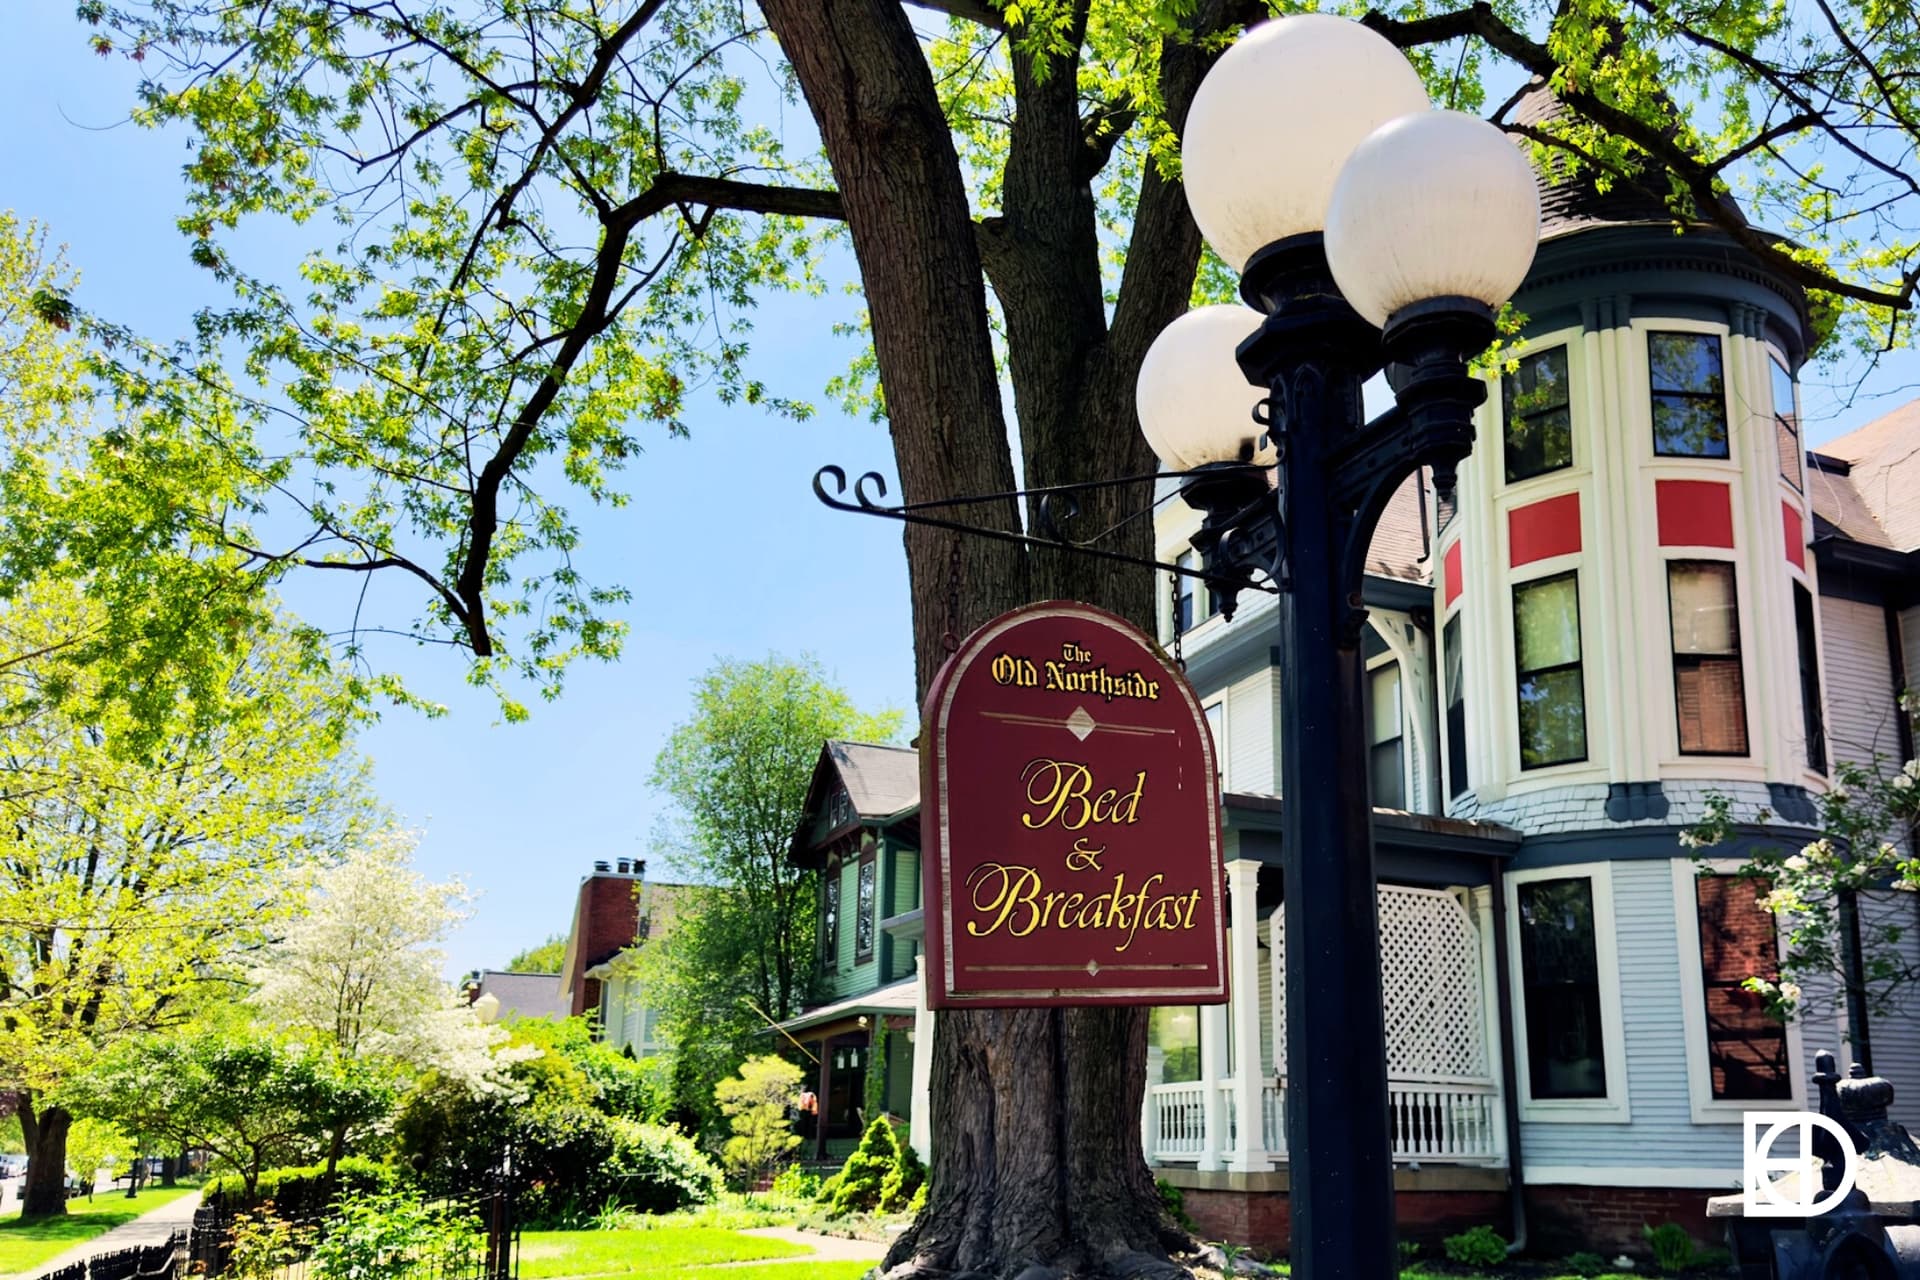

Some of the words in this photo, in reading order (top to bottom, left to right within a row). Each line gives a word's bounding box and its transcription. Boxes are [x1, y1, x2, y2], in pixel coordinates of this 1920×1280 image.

[1063, 643, 1091, 664] The
[991, 654, 1039, 687] Old
[1045, 661, 1160, 701] Northside
[1021, 758, 1147, 830] Bed
[1066, 837, 1105, 871] &
[965, 862, 1201, 952] Breakfast
